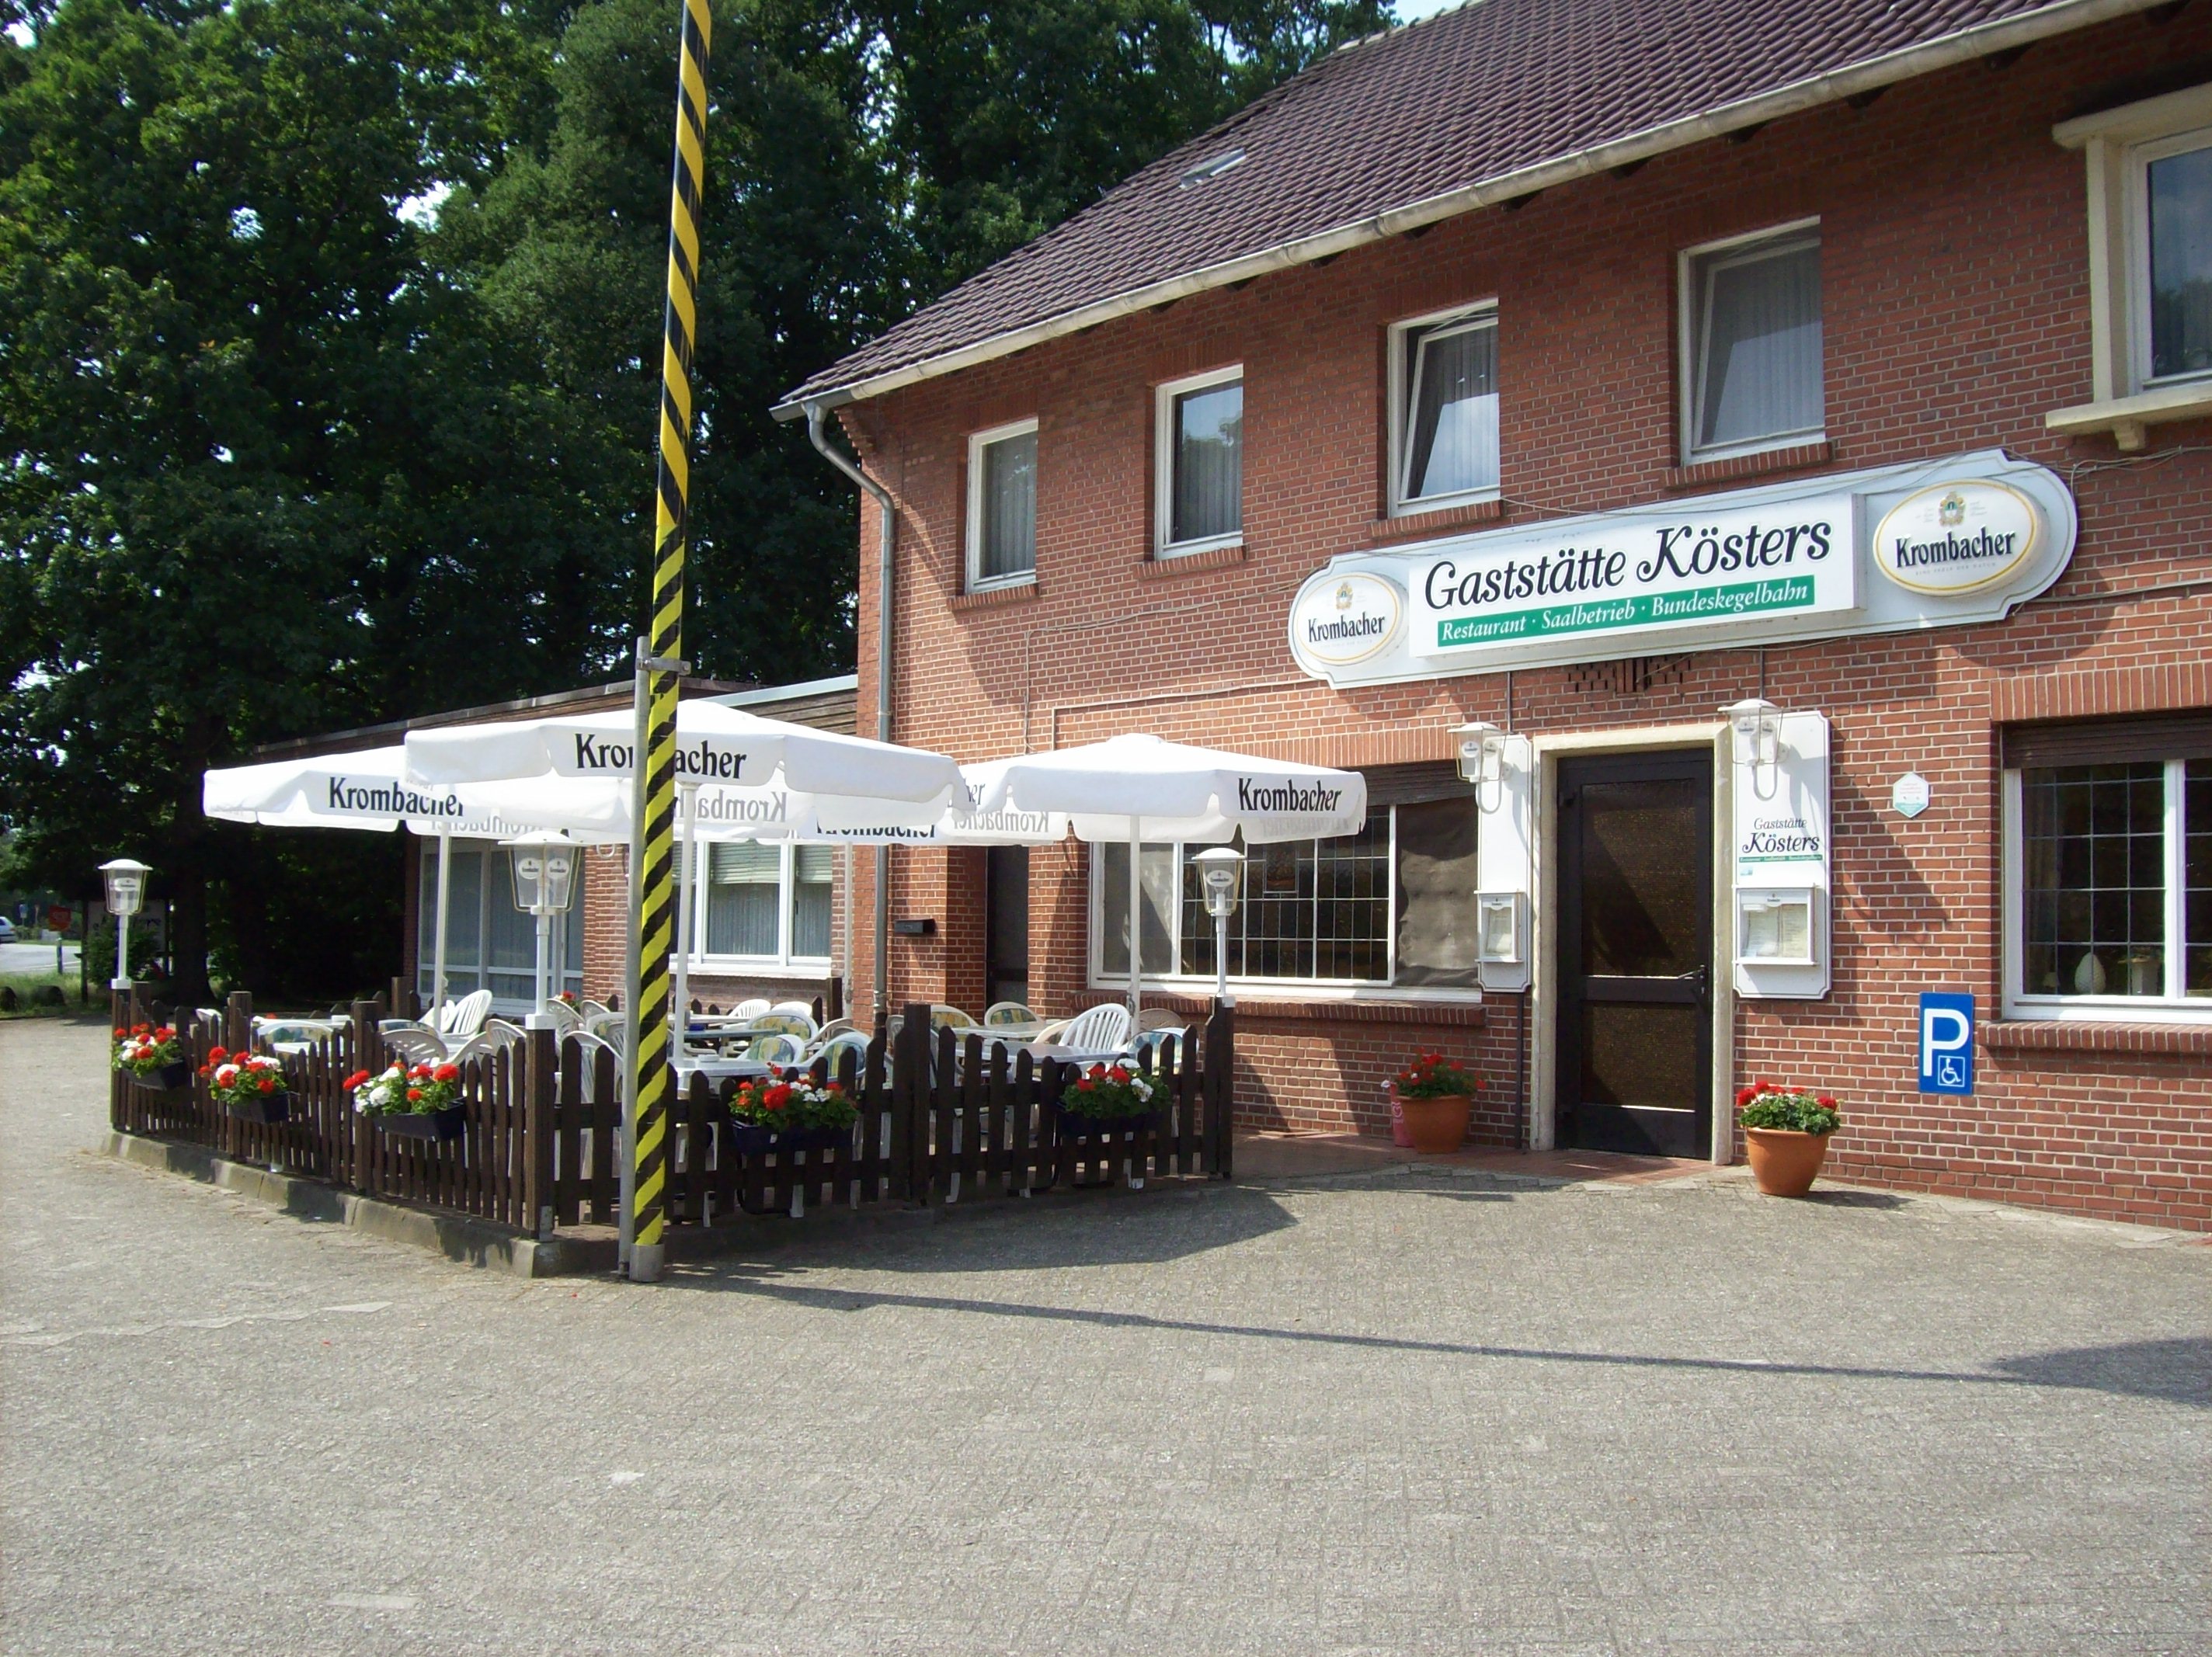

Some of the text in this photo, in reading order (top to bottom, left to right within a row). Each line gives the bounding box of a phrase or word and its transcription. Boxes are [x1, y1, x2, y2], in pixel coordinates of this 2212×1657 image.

[1424, 522, 1832, 610] Gaststätte Kösters
[1895, 525, 2016, 568] Krombacher
[1308, 611, 1386, 643] Krombacher
[1442, 579, 1809, 641] Restaurant Saalbetrieb Bundeskegelbahn
[575, 733, 747, 780] Kroacher
[1238, 777, 1342, 812] Krombacher
[1742, 832, 1820, 853] Kösters
[1754, 817, 1808, 830] Gaststätte
[1923, 1008, 1970, 1077] P
